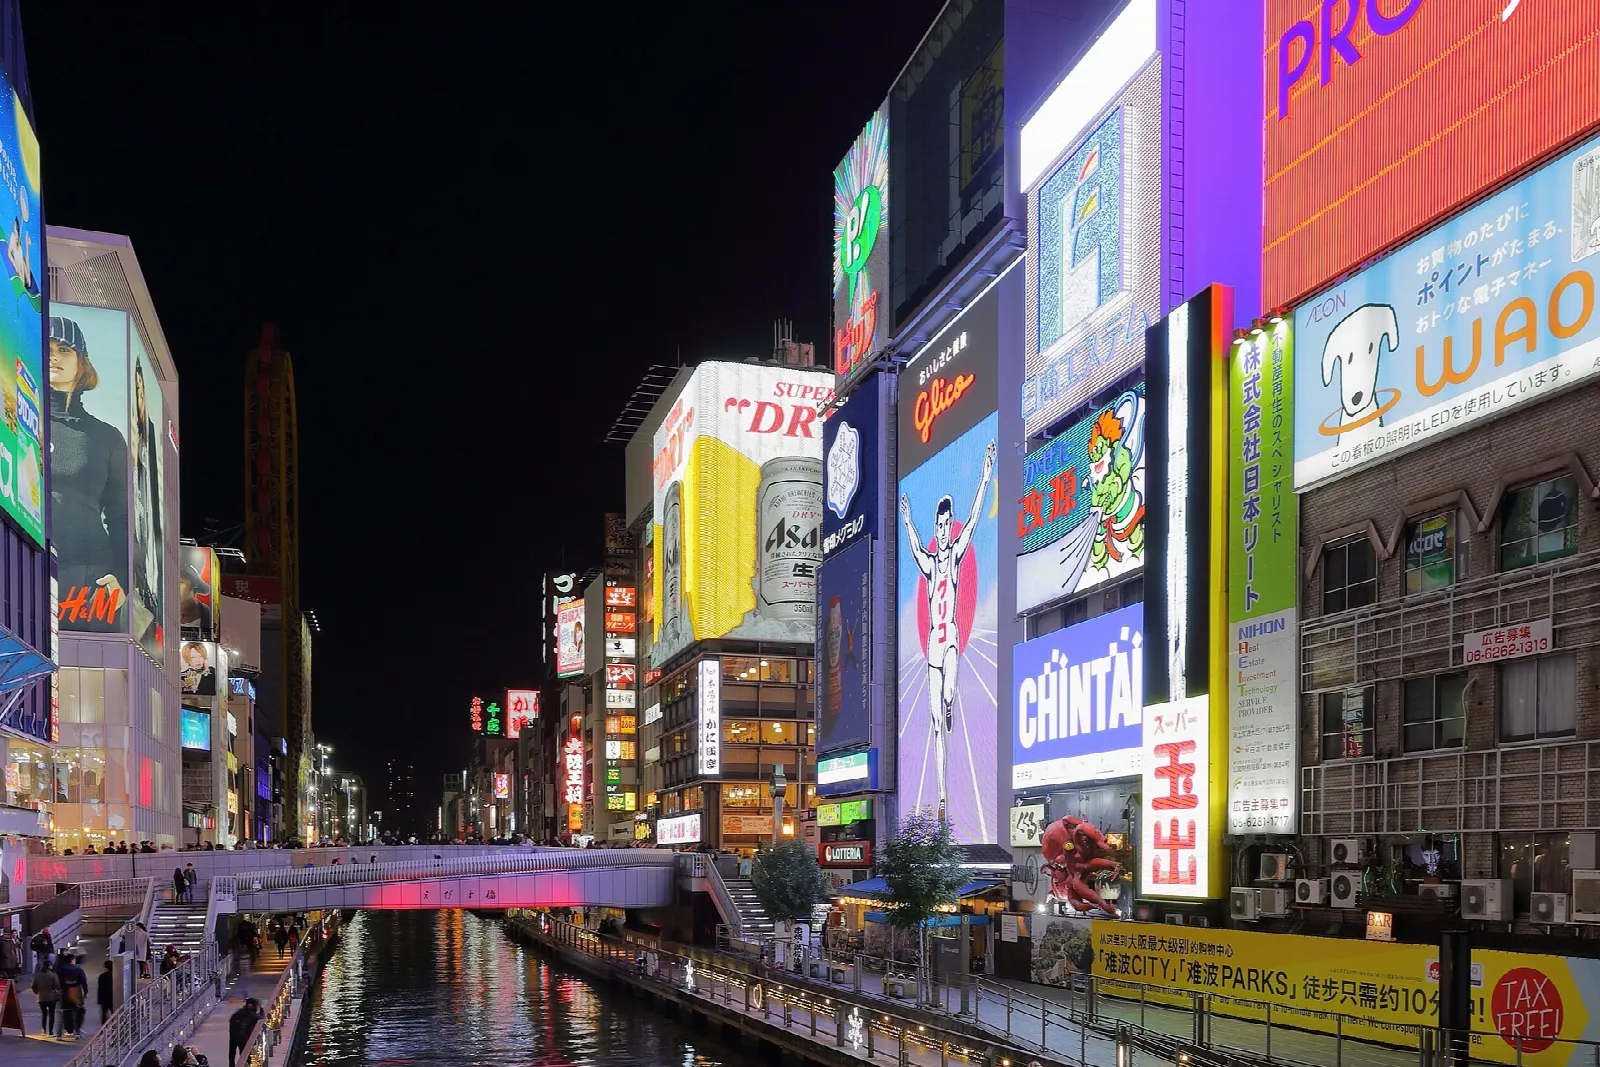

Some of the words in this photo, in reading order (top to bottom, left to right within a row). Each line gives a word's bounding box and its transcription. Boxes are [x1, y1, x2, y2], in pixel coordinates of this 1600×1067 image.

[1416, 201, 1530, 276] お買物のたびに
[1417, 220, 1564, 307] ポイントがたまる、
[1415, 258, 1552, 334] おトクな電子マネー
[838, 289, 878, 375] ピップ
[919, 331, 968, 386] おいしさと健康
[914, 373, 976, 443] Glico
[1330, 362, 1572, 468] この看板の照明はLEDを使用しています。
[1271, 332, 1284, 545] 不動産再生のスペシャリスト
[1024, 440, 1076, 486] かぜに
[1242, 344, 1261, 613] 株式会社日本リート
[1017, 467, 1077, 538] 改源
[793, 563, 815, 578] 生
[58, 583, 119, 624] H&M
[936, 575, 949, 644] グリコ
[1238, 617, 1285, 641] NIHON
[1482, 625, 1532, 647] 広告募集
[1238, 641, 1260, 655] Real
[1238, 655, 1266, 669] Estate
[1466, 638, 1549, 663] 06-6262-1313
[1019, 626, 1142, 749] CHINTAI
[1238, 669, 1277, 684] Investment
[1238, 684, 1279, 700] Technology
[1153, 708, 1198, 735] スーパー
[1151, 740, 1198, 885] 玉出
[1232, 815, 1289, 828] 06-6281-1717
[1233, 798, 1289, 812] 広告主募集中
[832, 847, 862, 860] LOTTERIA
[1367, 913, 1391, 928] BAR
[1501, 977, 1549, 1010] TAX
[1497, 1008, 1560, 1041] FREE!
